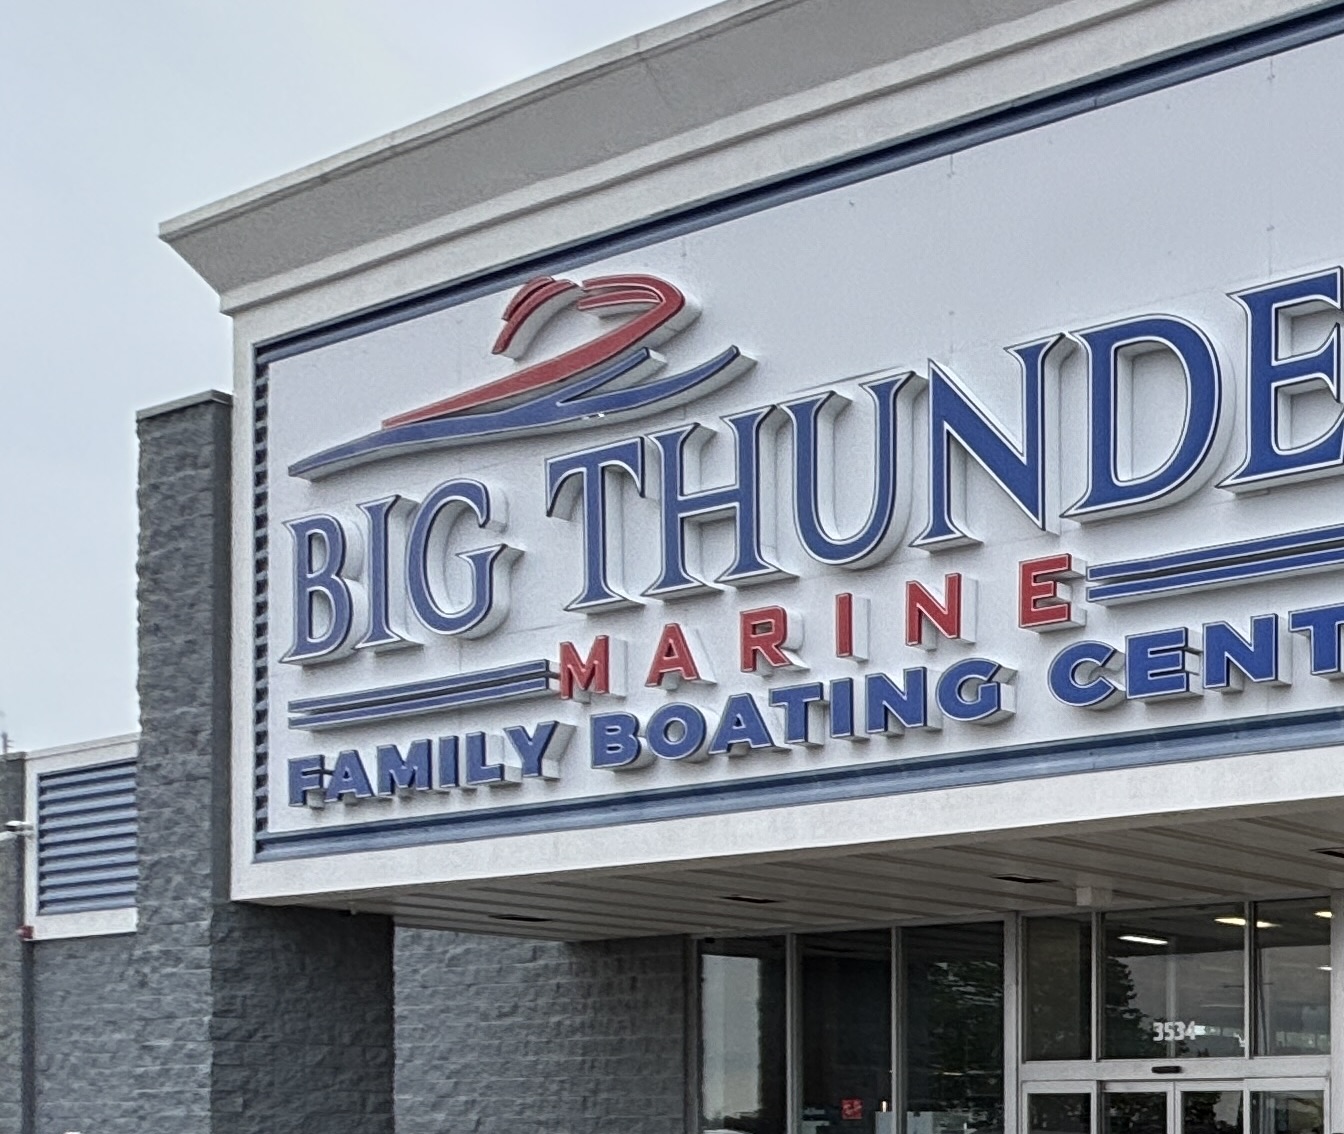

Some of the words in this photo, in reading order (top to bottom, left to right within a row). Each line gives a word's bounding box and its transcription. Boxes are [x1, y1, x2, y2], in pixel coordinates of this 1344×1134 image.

[280, 478, 510, 664] BIG
[558, 552, 1074, 700] MARINE
[288, 720, 560, 808] FAMILY
[589, 657, 1001, 770] BOATING
[1153, 1021, 1196, 1041] 3534
